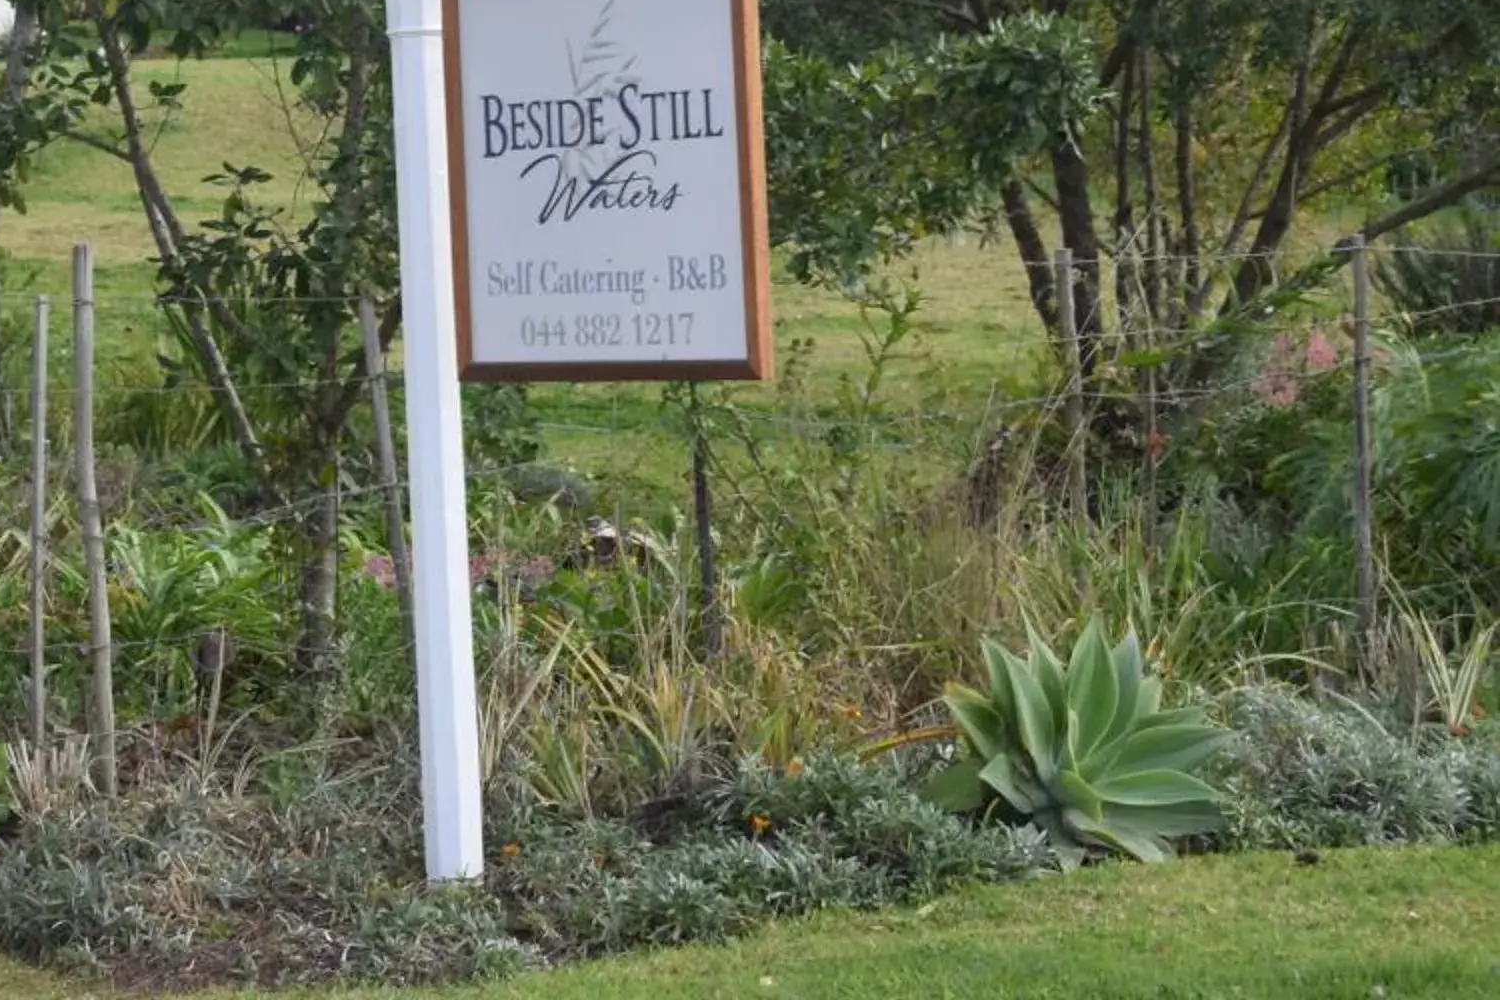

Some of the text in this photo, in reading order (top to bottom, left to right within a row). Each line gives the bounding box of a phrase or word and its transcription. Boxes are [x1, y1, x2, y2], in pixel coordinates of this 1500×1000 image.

[481, 83, 724, 158] BESIDE STILL
[519, 149, 684, 225] Waters
[486, 253, 728, 305] Self Catering B&B
[520, 311, 695, 347] 044 882 1217
